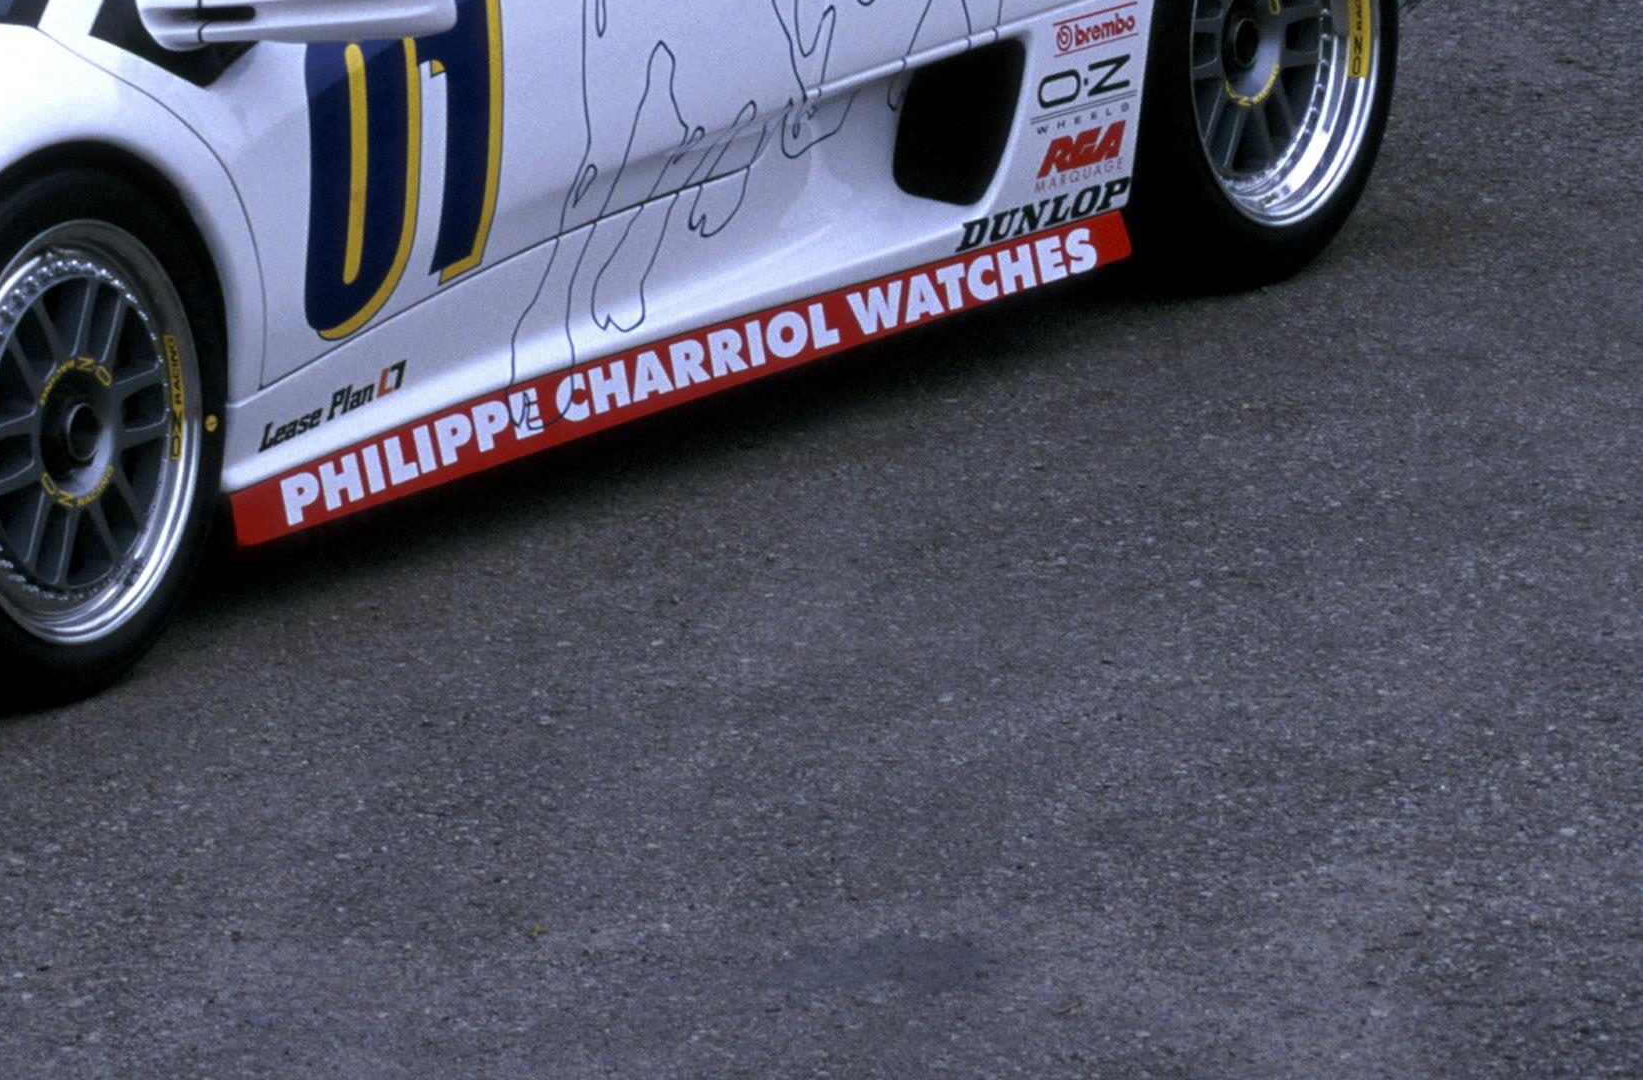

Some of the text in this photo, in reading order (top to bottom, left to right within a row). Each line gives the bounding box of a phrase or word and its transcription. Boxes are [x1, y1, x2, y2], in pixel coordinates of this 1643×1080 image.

[1074, 13, 1136, 46] brembo
[1036, 102, 1130, 136] WHEELS
[1033, 157, 1125, 194] MARQUAGE
[955, 176, 1132, 253] DUNLOP
[279, 227, 1098, 526] PHILIPPE CHARRIOL WATCHES
[258, 407, 324, 453] Lease
[326, 384, 375, 422] Plan
